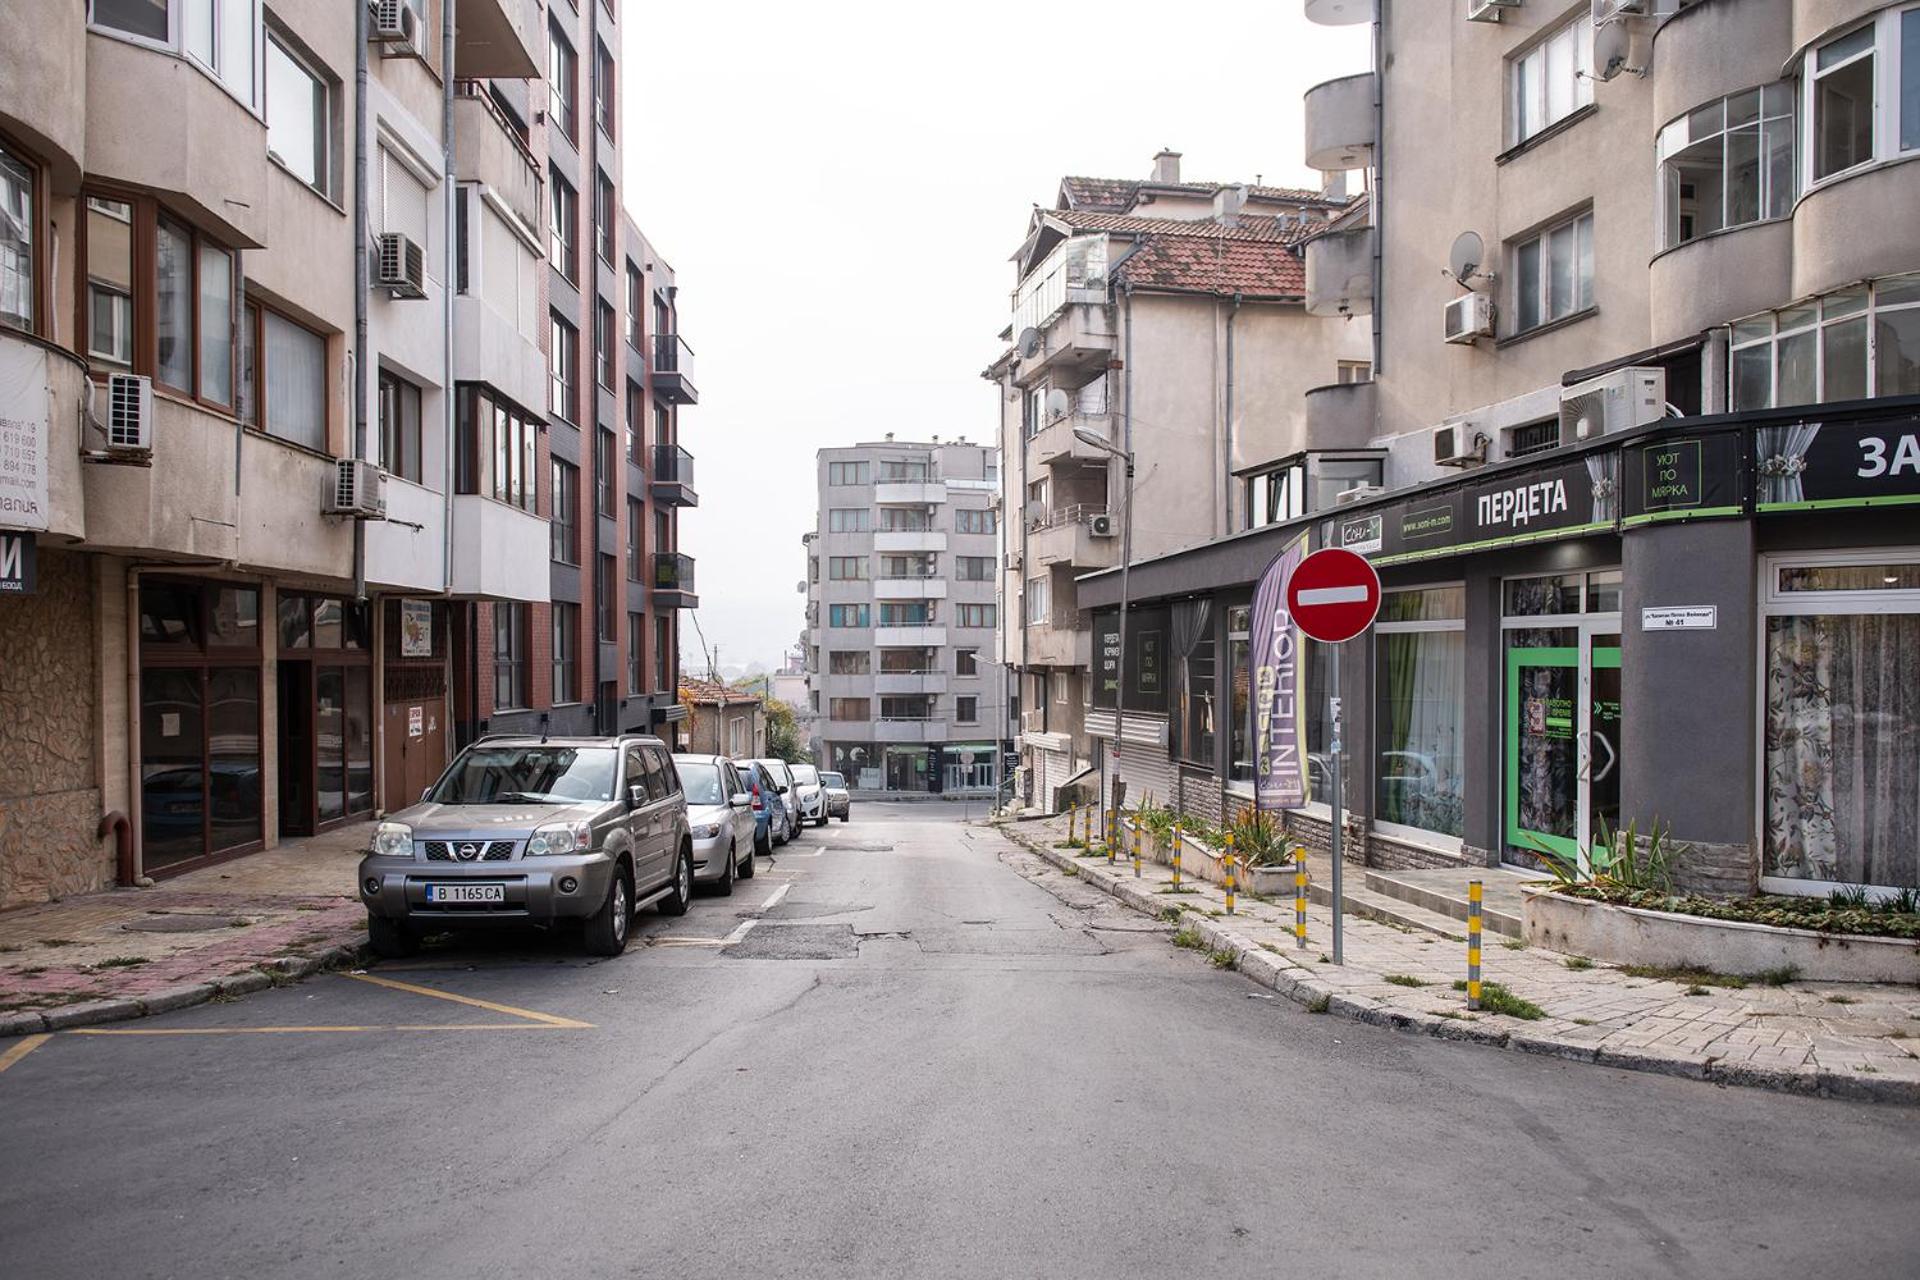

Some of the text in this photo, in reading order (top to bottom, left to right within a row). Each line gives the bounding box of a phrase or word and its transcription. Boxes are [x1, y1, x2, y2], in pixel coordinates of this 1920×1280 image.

[1660, 468, 1677, 482] ПО
[1477, 479, 1568, 528] ПЕРДЕТА
[438, 887, 447, 900] B
